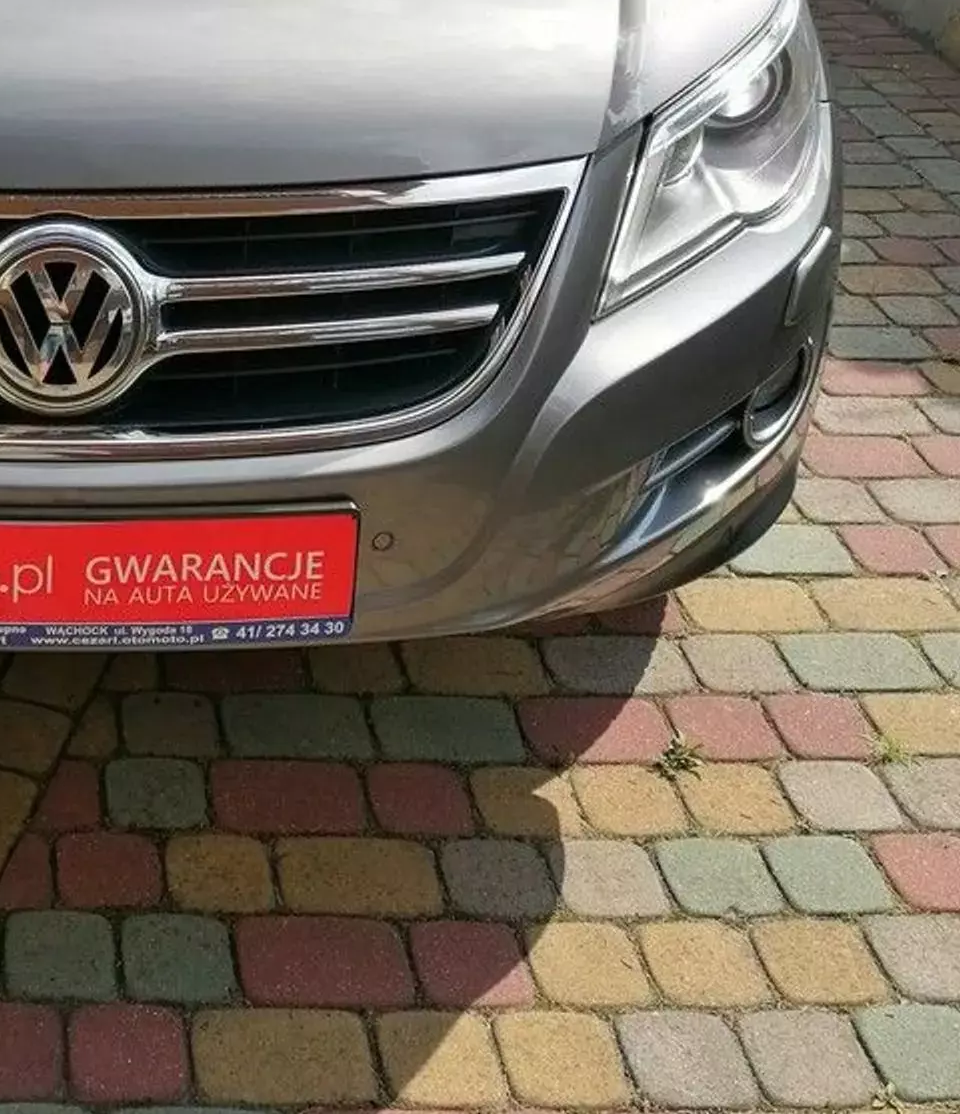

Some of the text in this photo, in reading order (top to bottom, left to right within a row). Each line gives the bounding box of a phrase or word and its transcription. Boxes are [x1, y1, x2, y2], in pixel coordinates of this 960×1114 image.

[85, 550, 325, 586] GWARANCJE
[84, 581, 322, 606] NA AUTA UŻYWANE
[131, 625, 177, 638] Wygoda
[265, 623, 296, 638] 274
[300, 621, 320, 636] 34
[323, 620, 345, 635] 30
